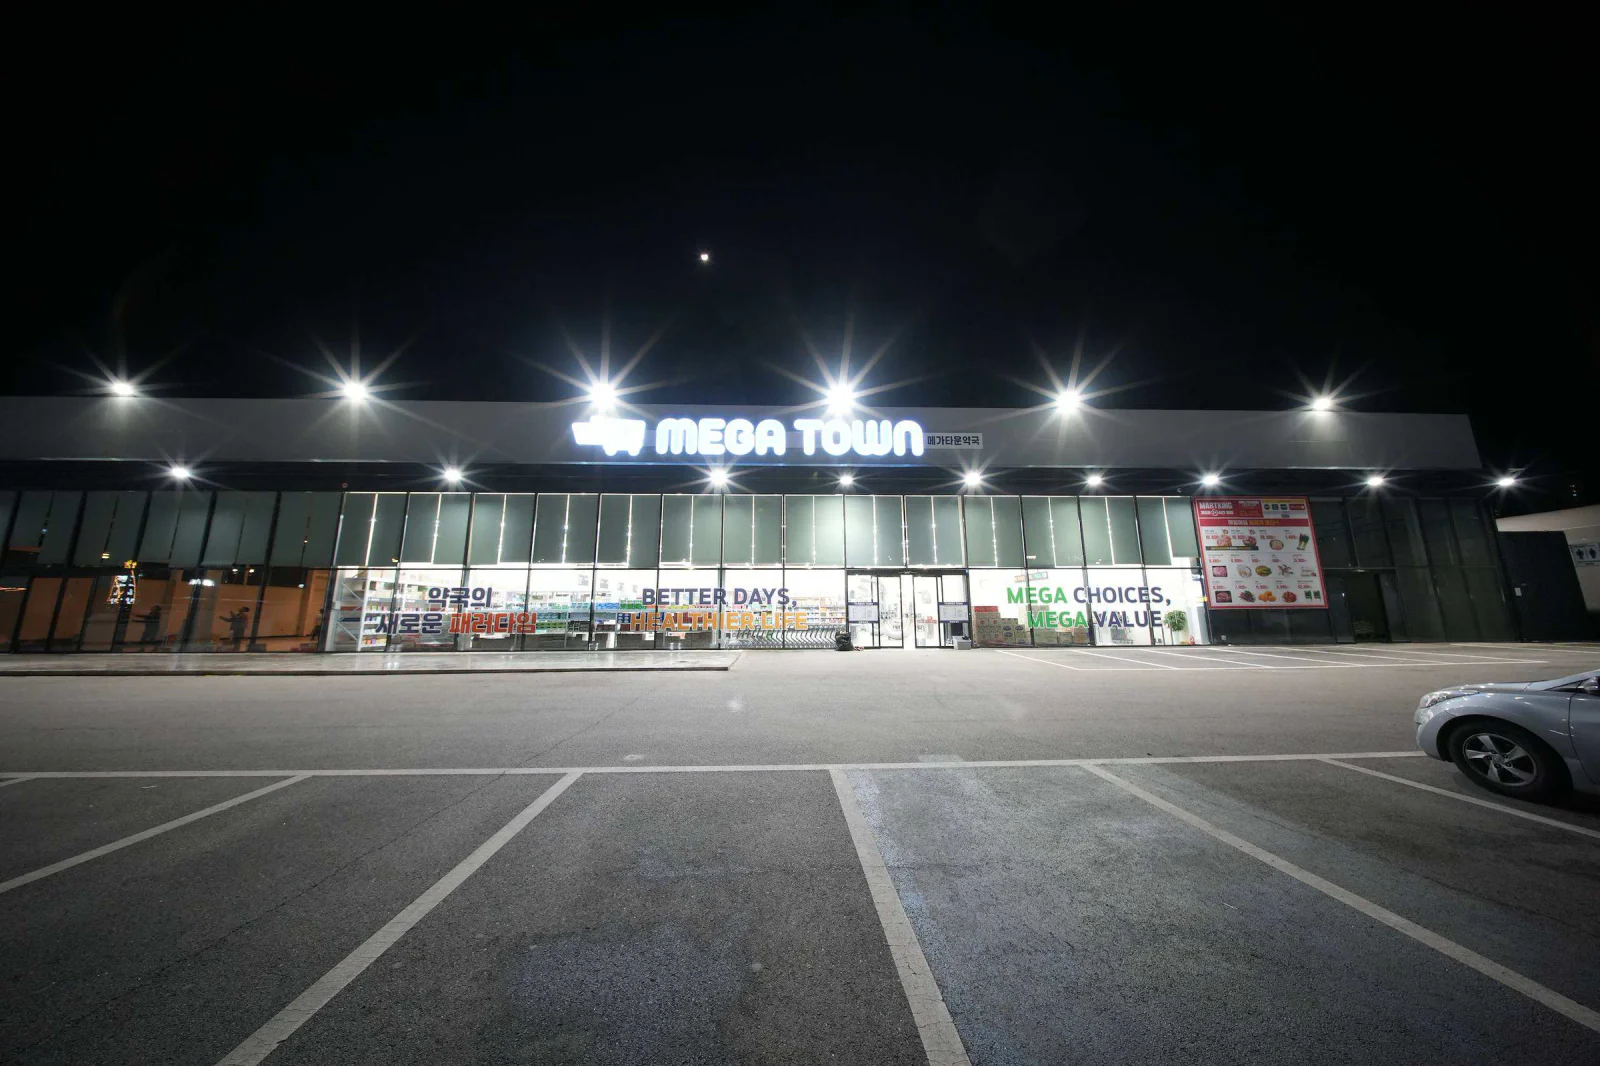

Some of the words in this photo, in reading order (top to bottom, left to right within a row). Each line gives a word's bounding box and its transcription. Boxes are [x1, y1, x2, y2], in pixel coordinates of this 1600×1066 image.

[655, 417, 786, 455] MEGA
[793, 418, 924, 456] TOWN
[926, 435, 980, 446] 메가타운약국
[428, 587, 493, 608] 약국의
[642, 588, 726, 605] BETTER
[734, 588, 797, 607] DAYS,
[1007, 587, 1068, 604] MEGA
[1073, 586, 1171, 606] CHOICES,
[376, 612, 443, 634] 새로운
[449, 612, 537, 634] 패러다임
[630, 612, 754, 631] HEALTHIER
[760, 612, 809, 630] LIFE
[1026, 610, 1090, 628] MEGA
[1093, 610, 1163, 628] VALUE
